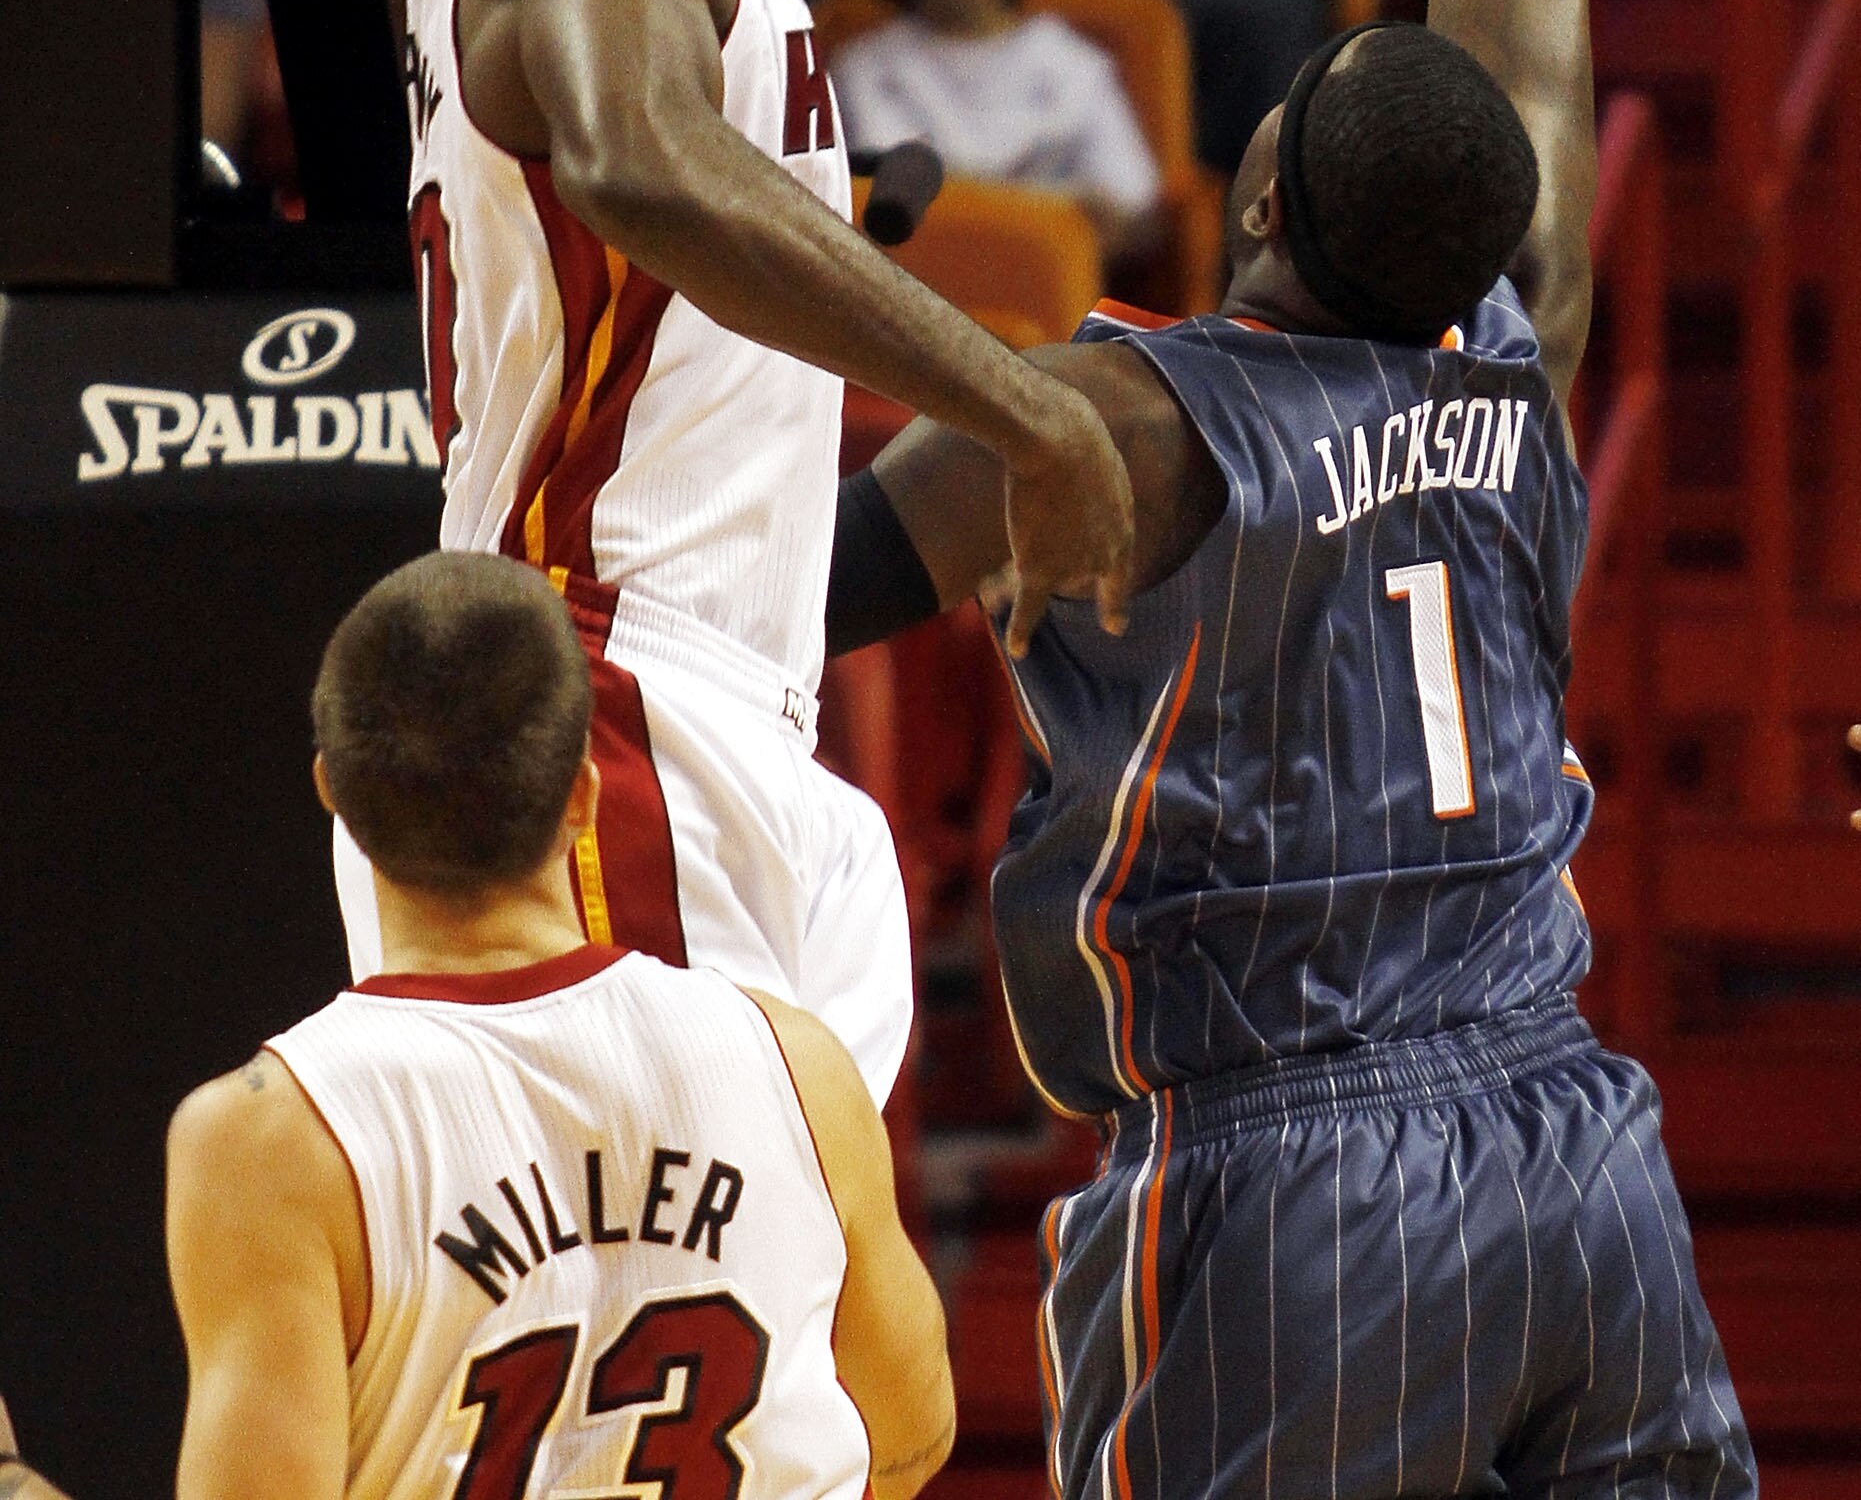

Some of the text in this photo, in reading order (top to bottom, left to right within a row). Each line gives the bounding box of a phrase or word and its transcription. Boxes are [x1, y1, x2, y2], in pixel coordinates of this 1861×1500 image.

[78, 382, 441, 483] SPALDIN
[1313, 398, 1529, 535] JACKSON
[1385, 560, 1476, 819] 1
[434, 1148, 745, 1307] MILLER
[449, 1289, 772, 1500] 13
